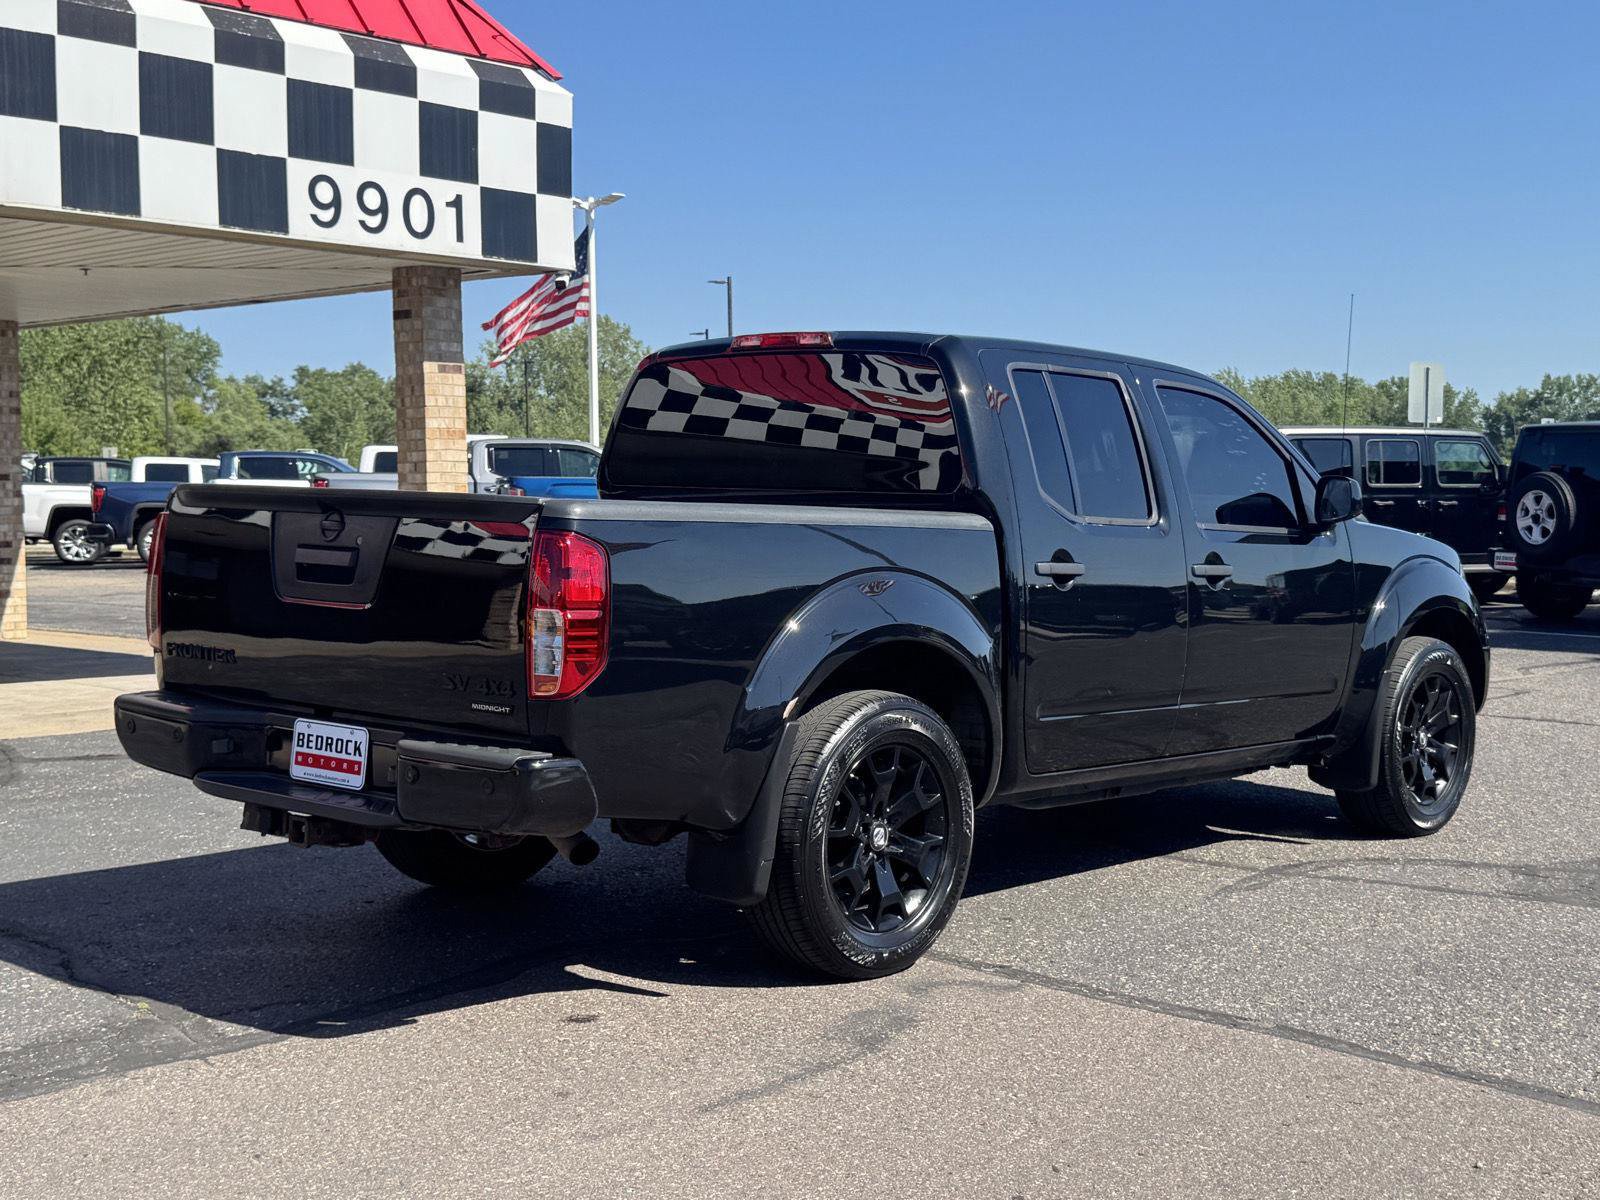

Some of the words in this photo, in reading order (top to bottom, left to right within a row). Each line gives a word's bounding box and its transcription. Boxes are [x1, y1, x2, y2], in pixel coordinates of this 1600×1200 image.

[308, 174, 464, 243] 9901
[166, 642, 238, 664] FRONTIER
[442, 672, 471, 692] SV
[471, 703, 511, 714] MIDNIGHT
[296, 732, 363, 757] BEDROCK
[297, 755, 359, 772] MOTORS
